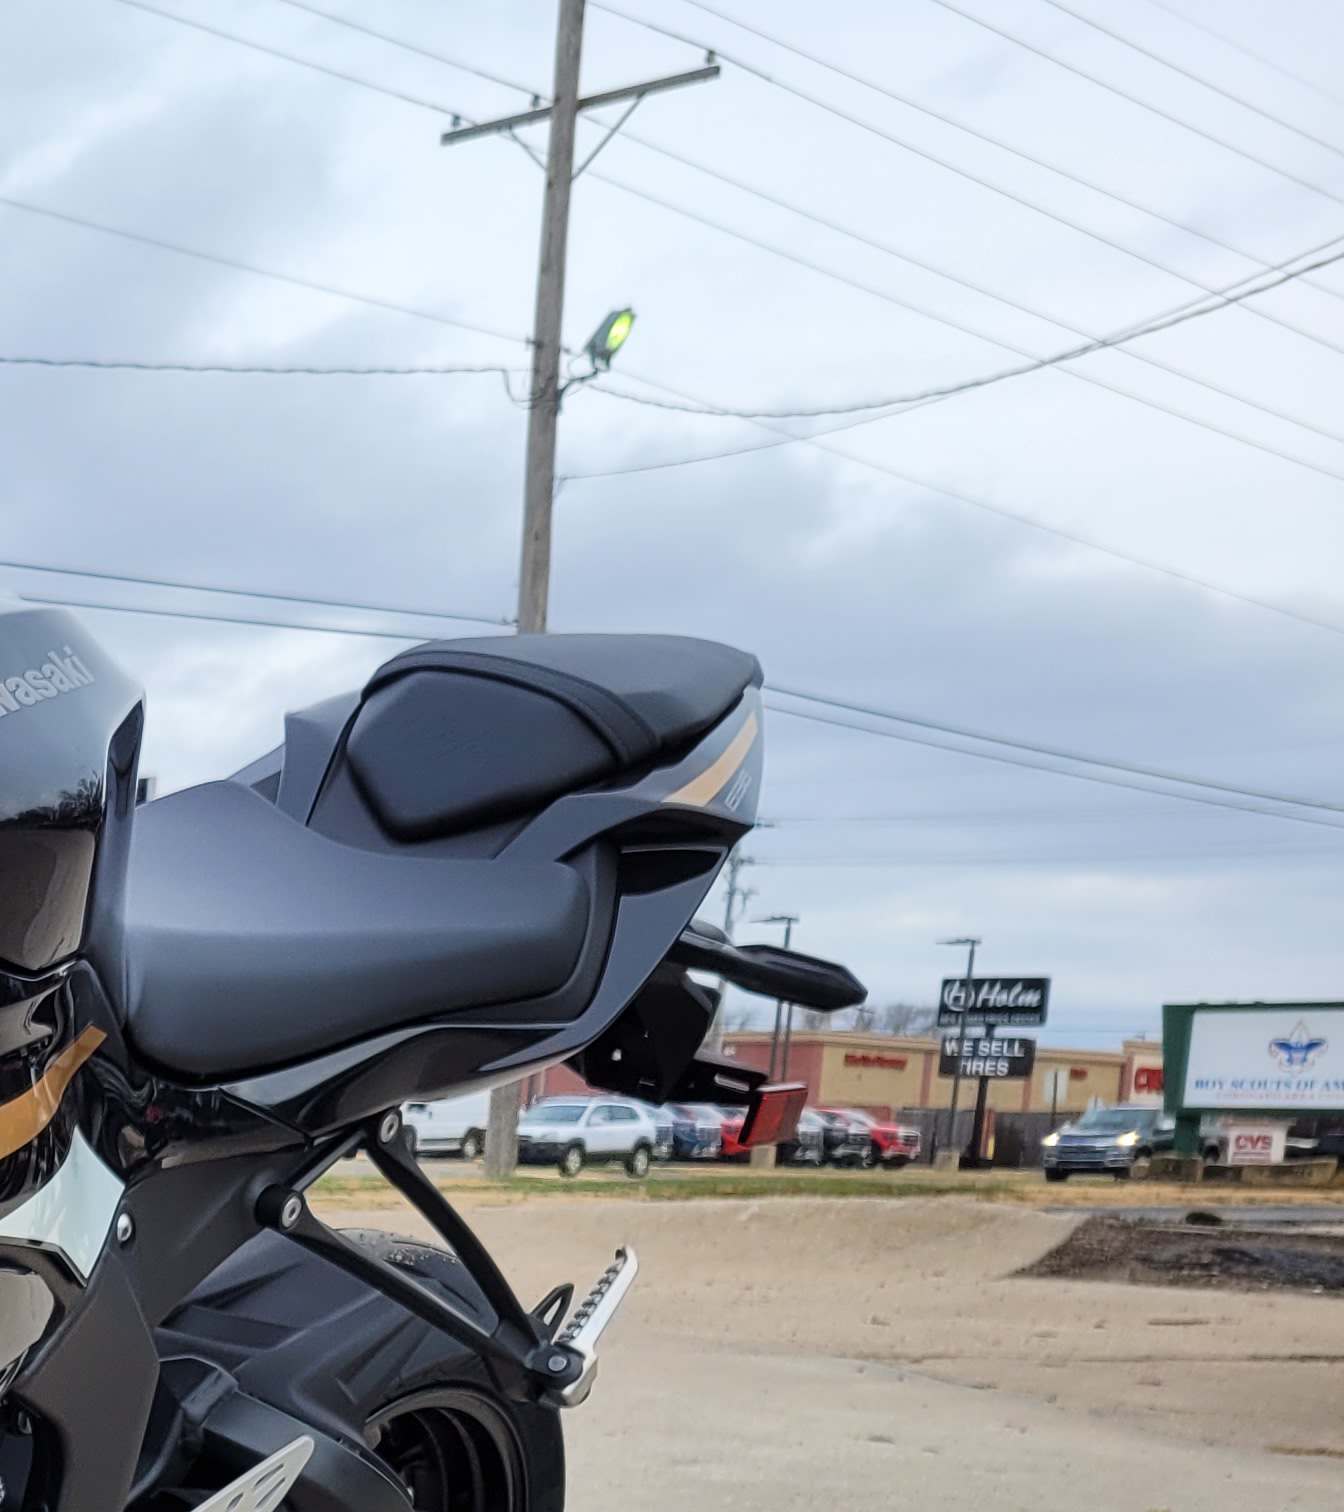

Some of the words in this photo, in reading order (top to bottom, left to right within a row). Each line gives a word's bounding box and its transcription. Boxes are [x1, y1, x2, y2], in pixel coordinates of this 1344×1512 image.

[978, 1040, 1025, 1057] SELL
[1231, 1079, 1291, 1090] SCOUTS
[1296, 1079, 1314, 1091] OF
[1235, 1135, 1273, 1150] CVS
